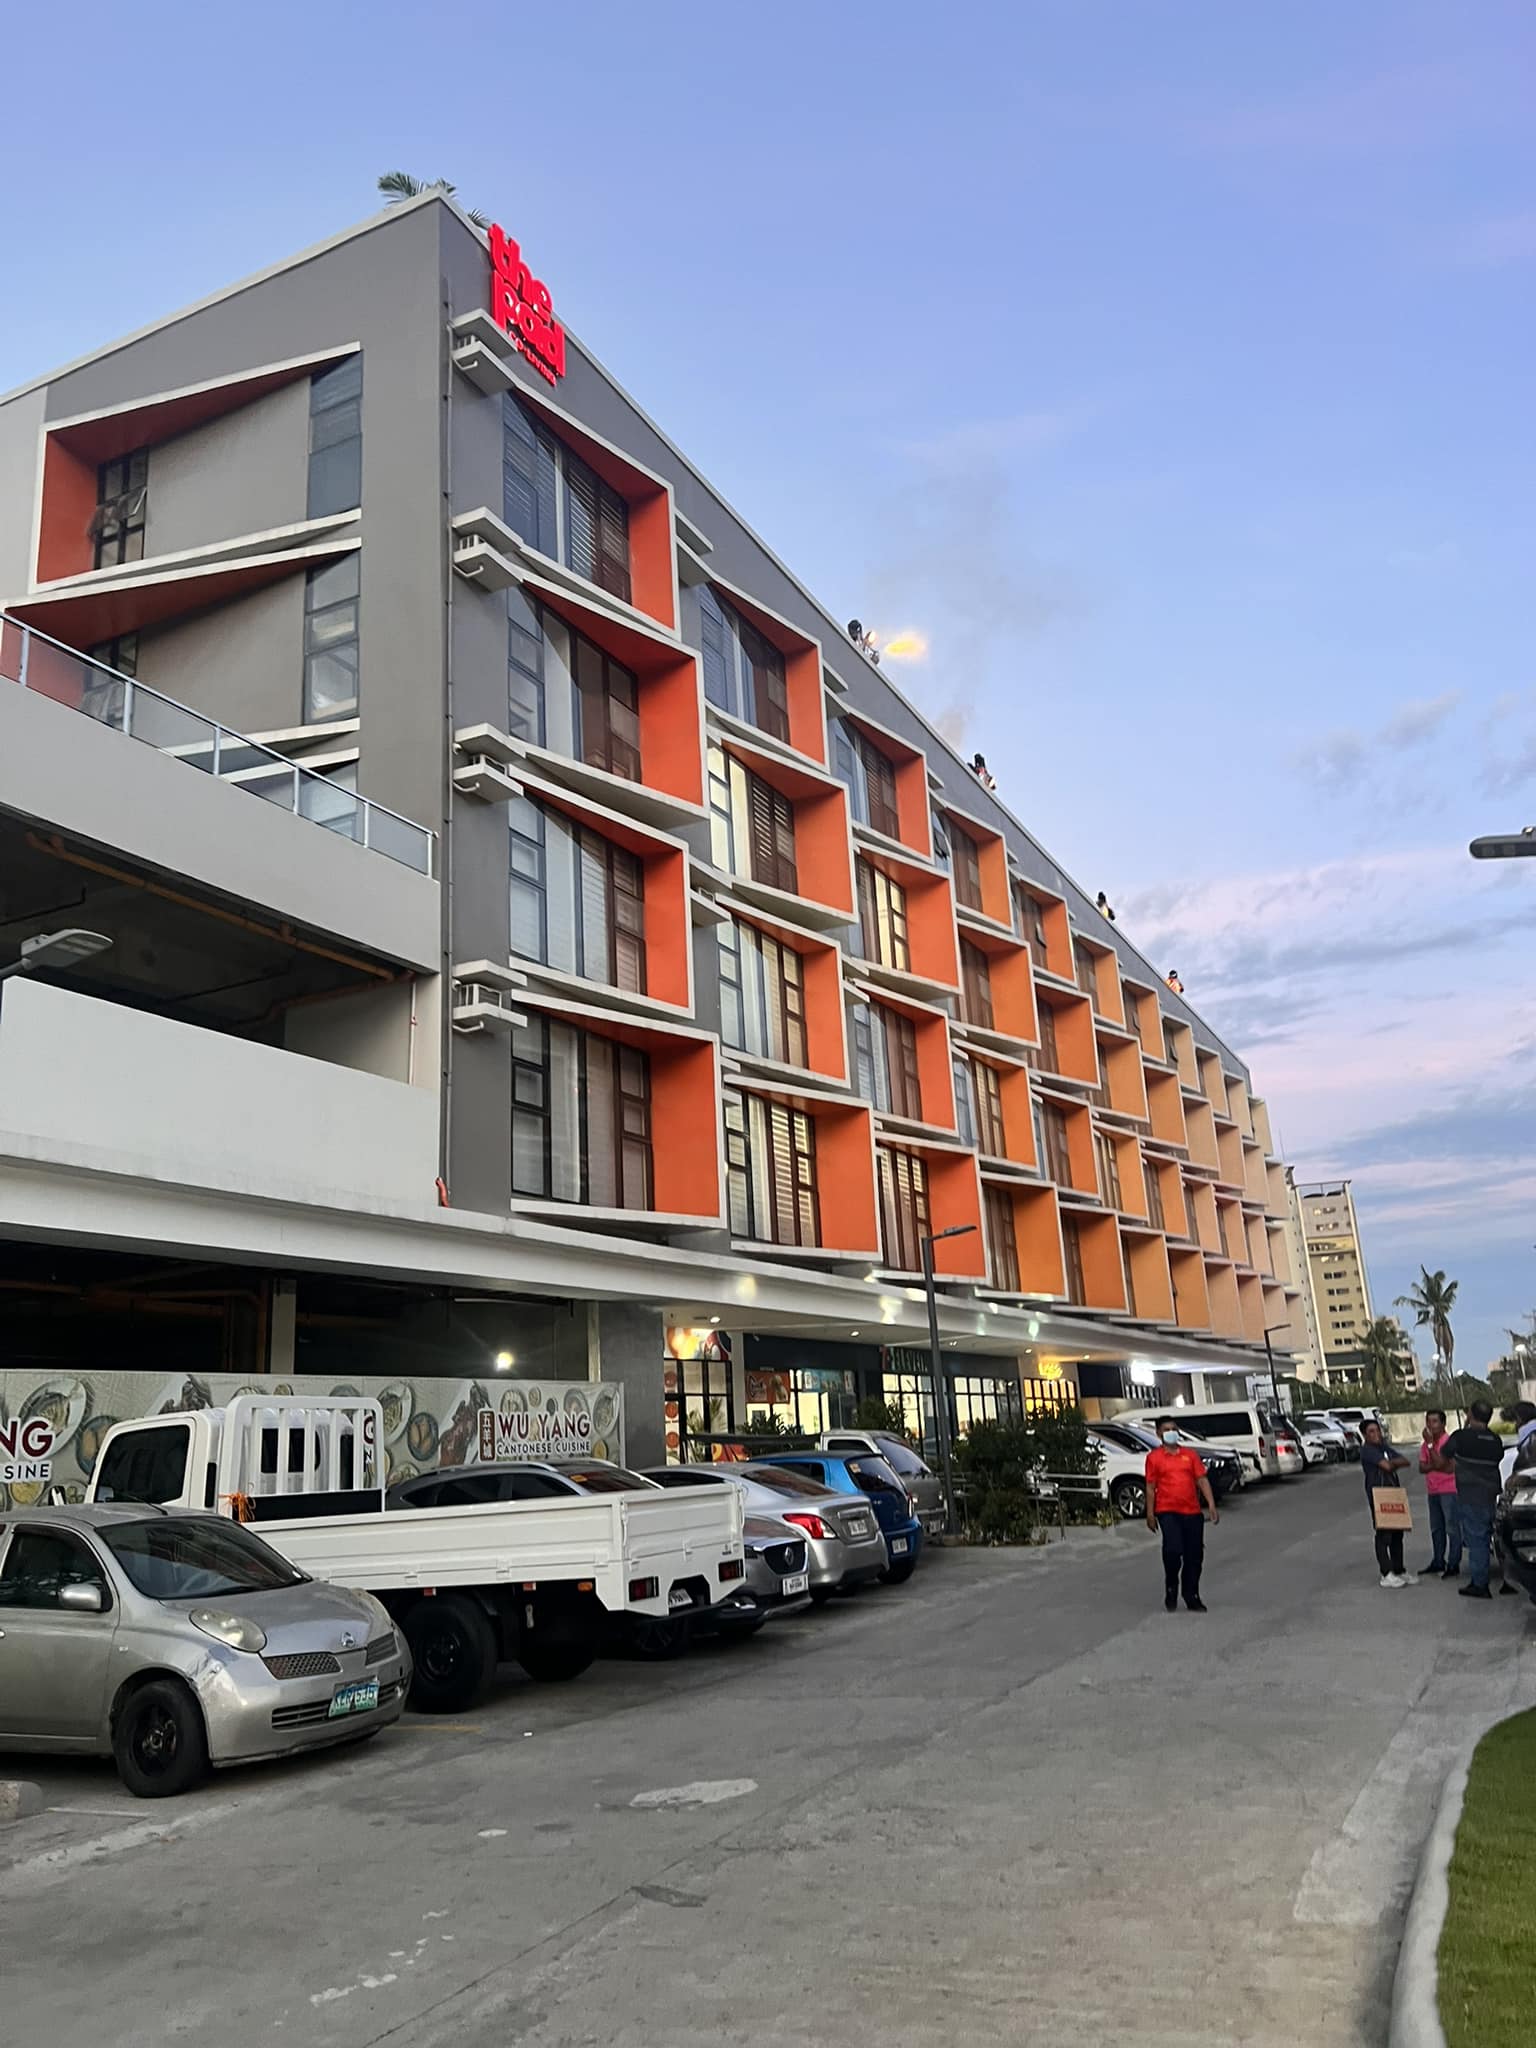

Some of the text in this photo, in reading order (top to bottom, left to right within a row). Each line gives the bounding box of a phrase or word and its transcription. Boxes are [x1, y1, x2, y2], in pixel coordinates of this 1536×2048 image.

[488, 223, 552, 322] the
[491, 271, 565, 378] pod
[497, 1441, 590, 1455] CANTONESE CUISINE
[498, 1413, 591, 1439] WU YANG
